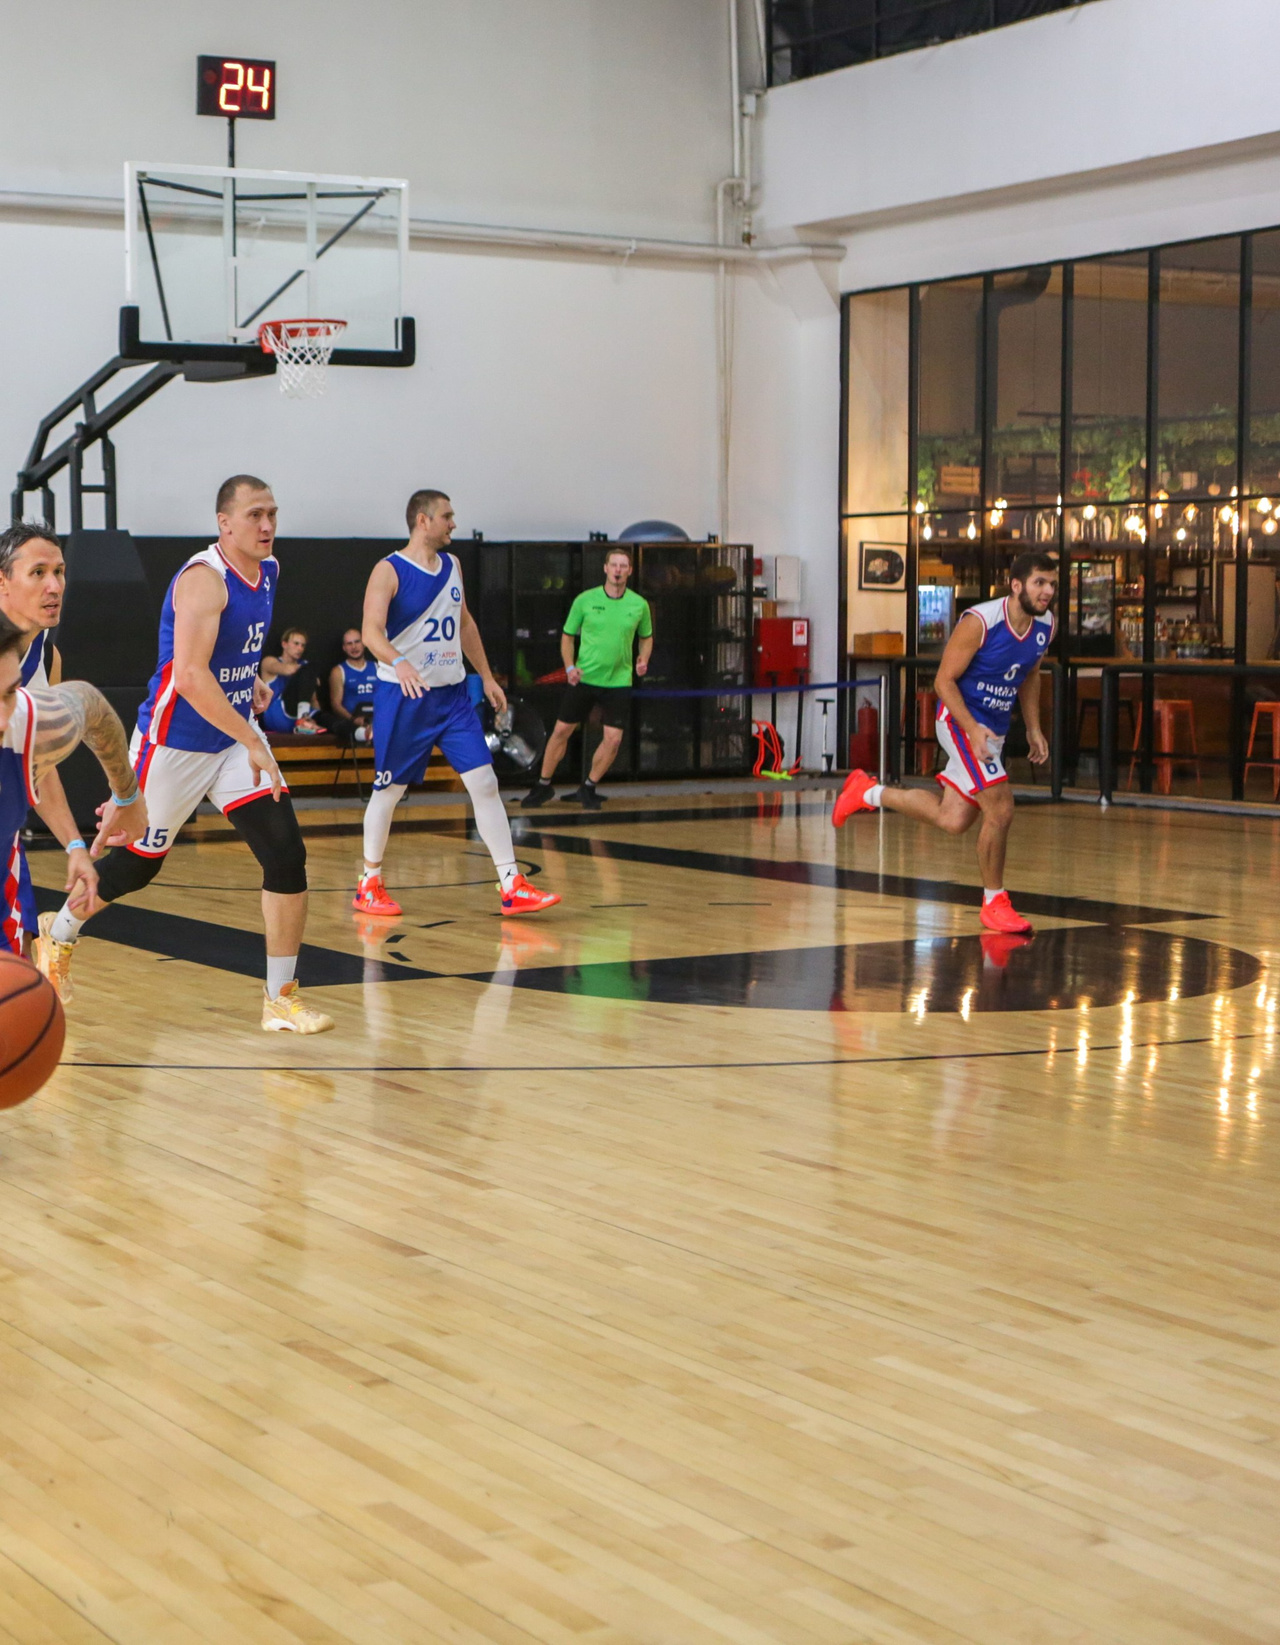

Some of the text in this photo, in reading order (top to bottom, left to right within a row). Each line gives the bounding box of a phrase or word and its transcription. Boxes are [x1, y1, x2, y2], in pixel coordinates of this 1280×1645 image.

[219, 62, 270, 112] 24
[242, 622, 264, 654] 15
[423, 616, 455, 642] 20
[374, 770, 392, 786] 20
[140, 826, 169, 848] 15
